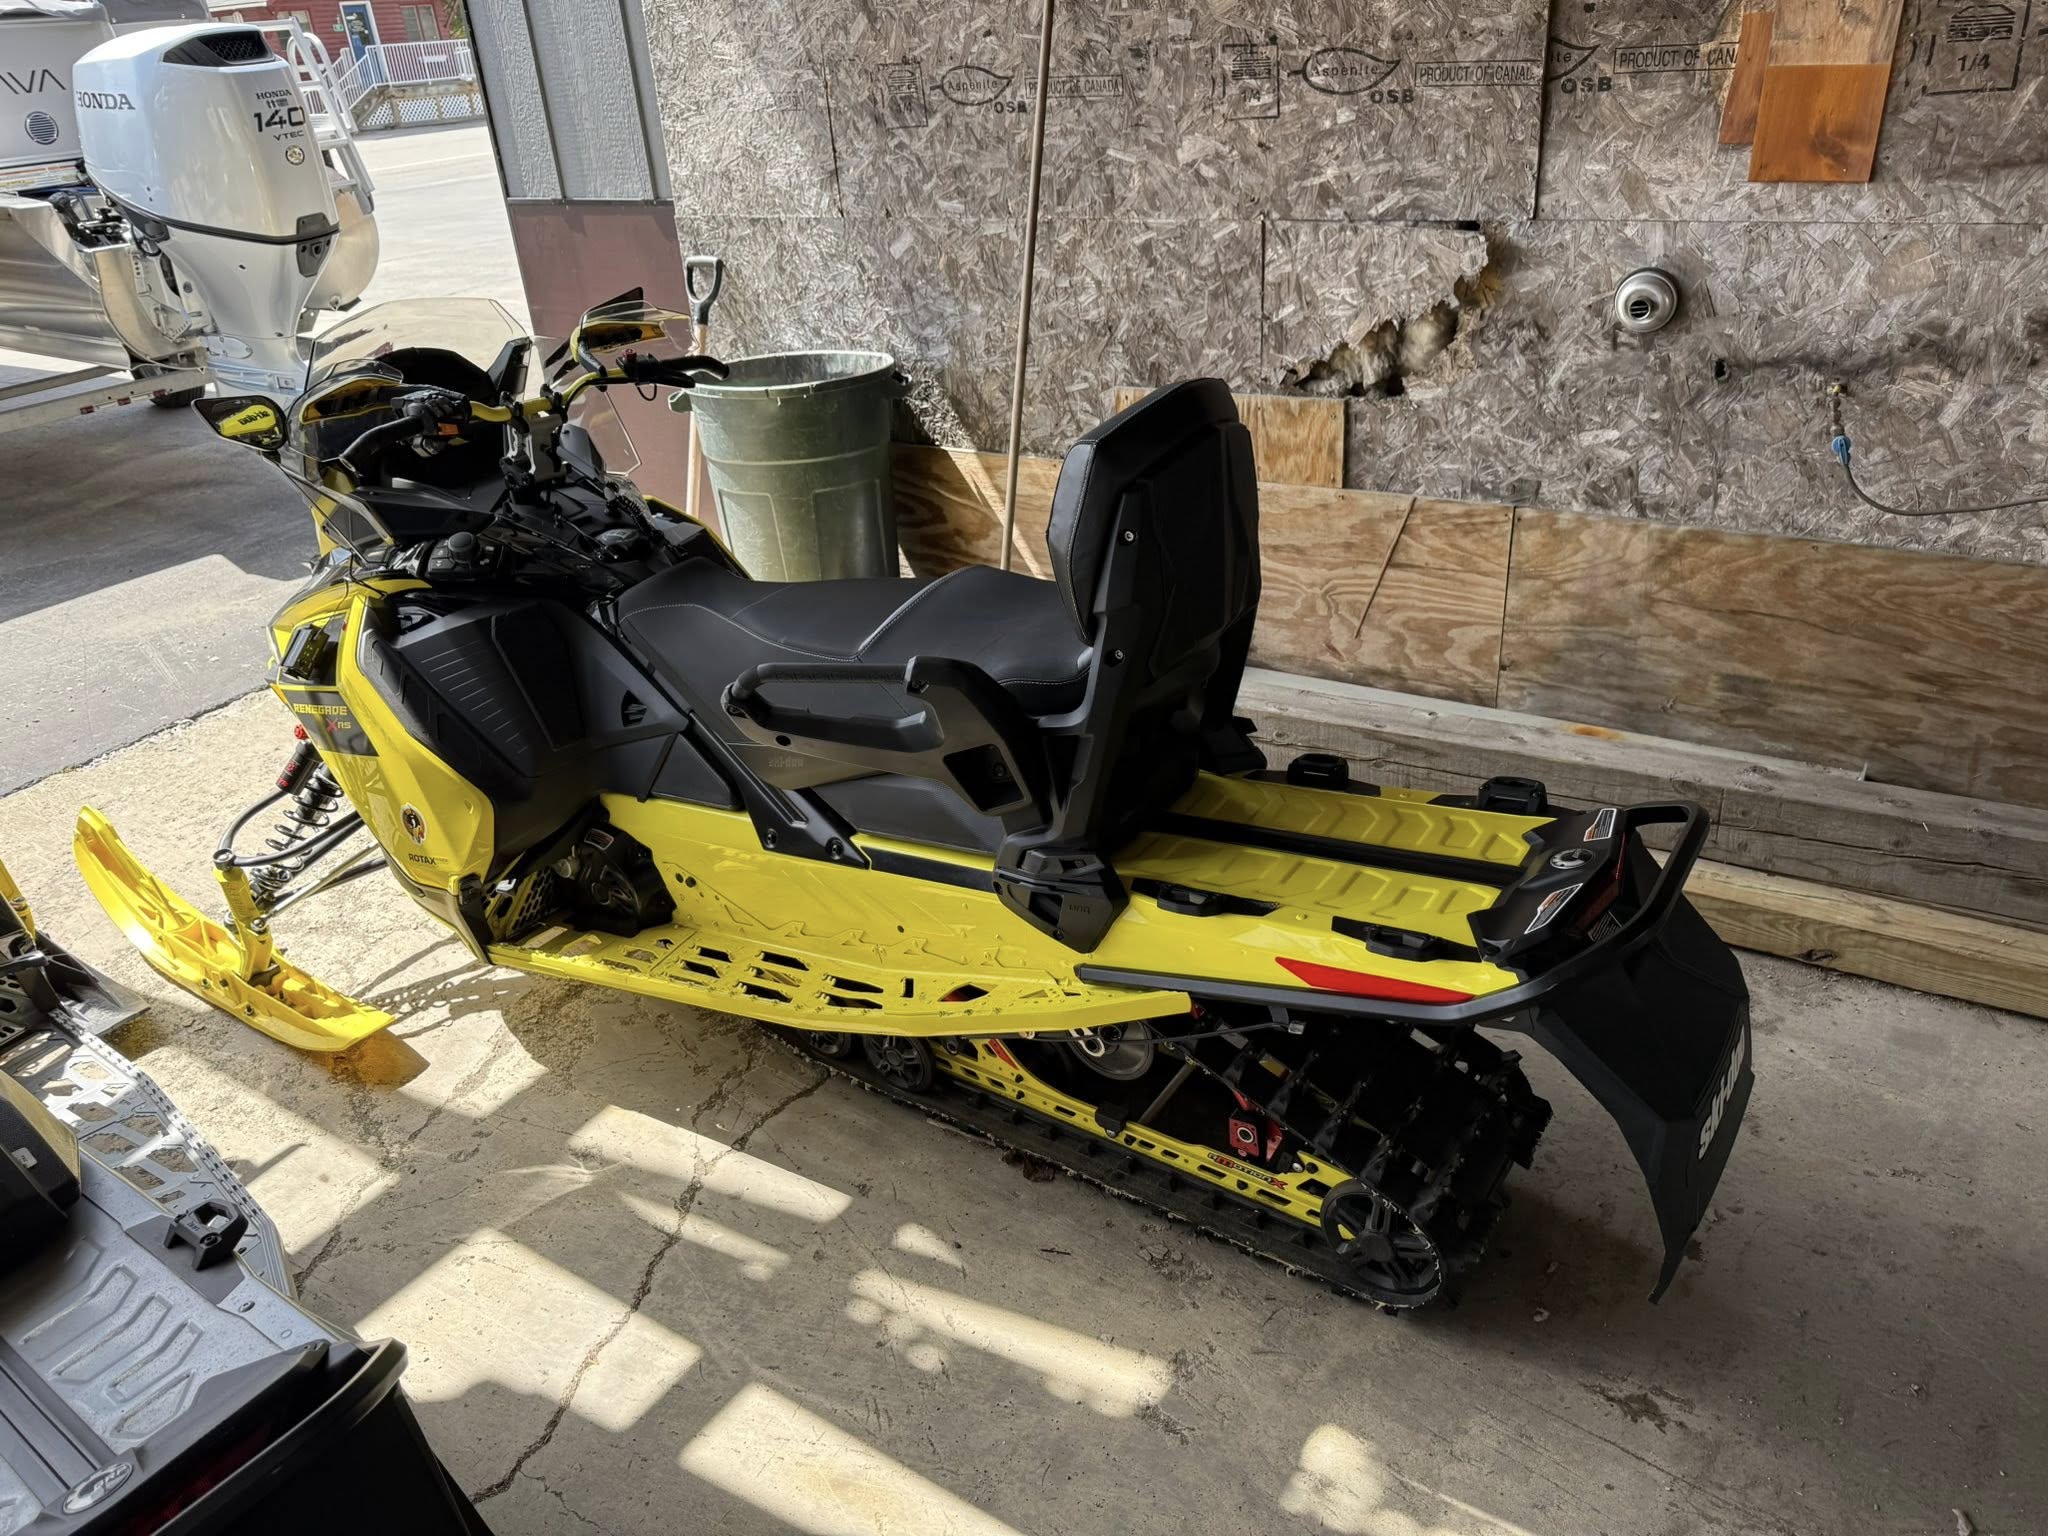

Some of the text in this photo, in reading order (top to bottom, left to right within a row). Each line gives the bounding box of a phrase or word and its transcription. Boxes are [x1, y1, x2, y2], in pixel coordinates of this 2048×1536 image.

[1619, 47, 1739, 68] PRODUCT OF CAN
[1958, 53, 1990, 71] 1/4
[1420, 66, 1470, 82] PRODUCT
[1475, 64, 1490, 82] OF
[947, 80, 998, 92] Aspenite
[1028, 80, 1066, 95] PRUCT
[1084, 79, 1120, 93] CANADA
[1561, 76, 1612, 93] OSB
[76, 91, 136, 110] HONDA
[255, 89, 293, 100] HONDA
[1368, 89, 1415, 104] OSB
[993, 100, 1028, 114] OSB
[253, 106, 306, 133] 140
[273, 130, 305, 141] VTEC
[292, 703, 348, 715] RENEGADE
[408, 853, 437, 866] ROTAX
